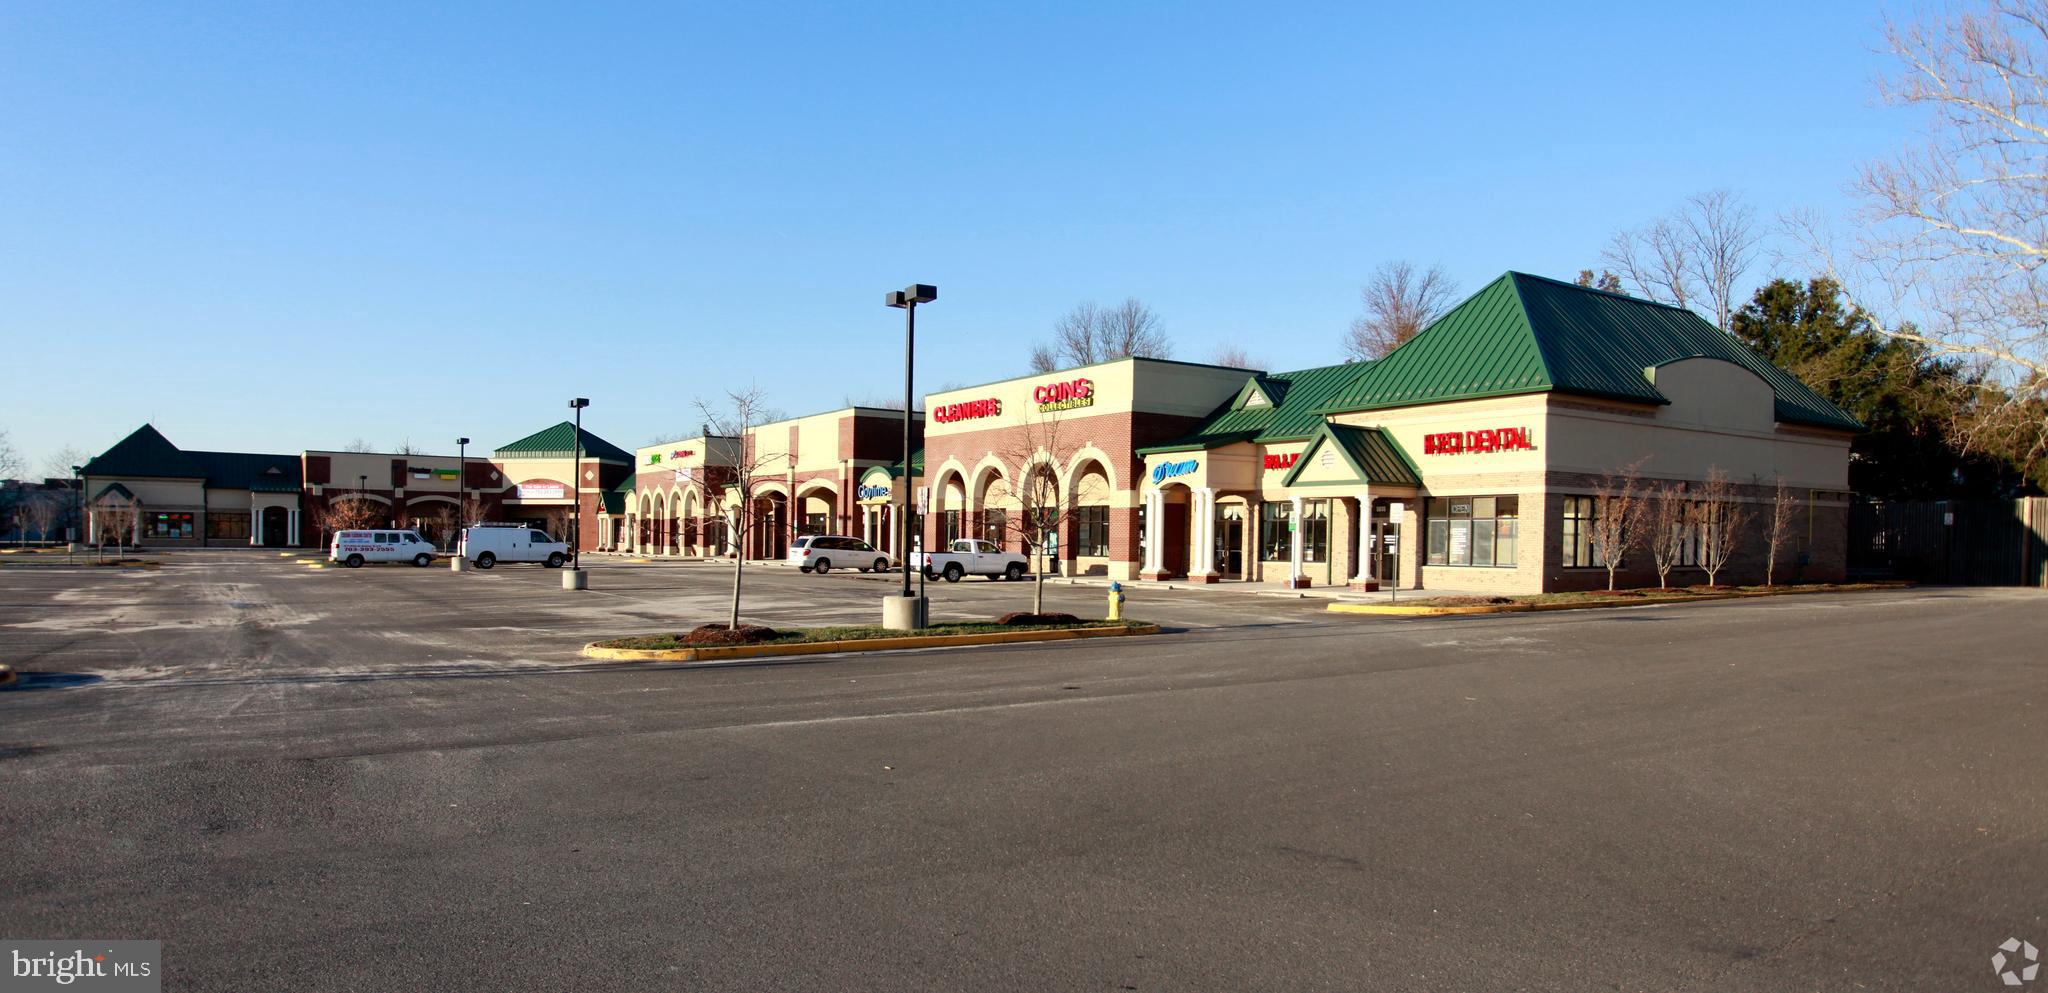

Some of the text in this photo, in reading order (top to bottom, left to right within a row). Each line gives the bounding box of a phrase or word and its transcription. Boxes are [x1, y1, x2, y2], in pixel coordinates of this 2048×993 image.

[1033, 378, 1092, 404] COINS
[933, 398, 1001, 423] CLEANERS
[1039, 398, 1093, 412] COLLECTIBLES
[1465, 427, 1533, 453] DENTAL
